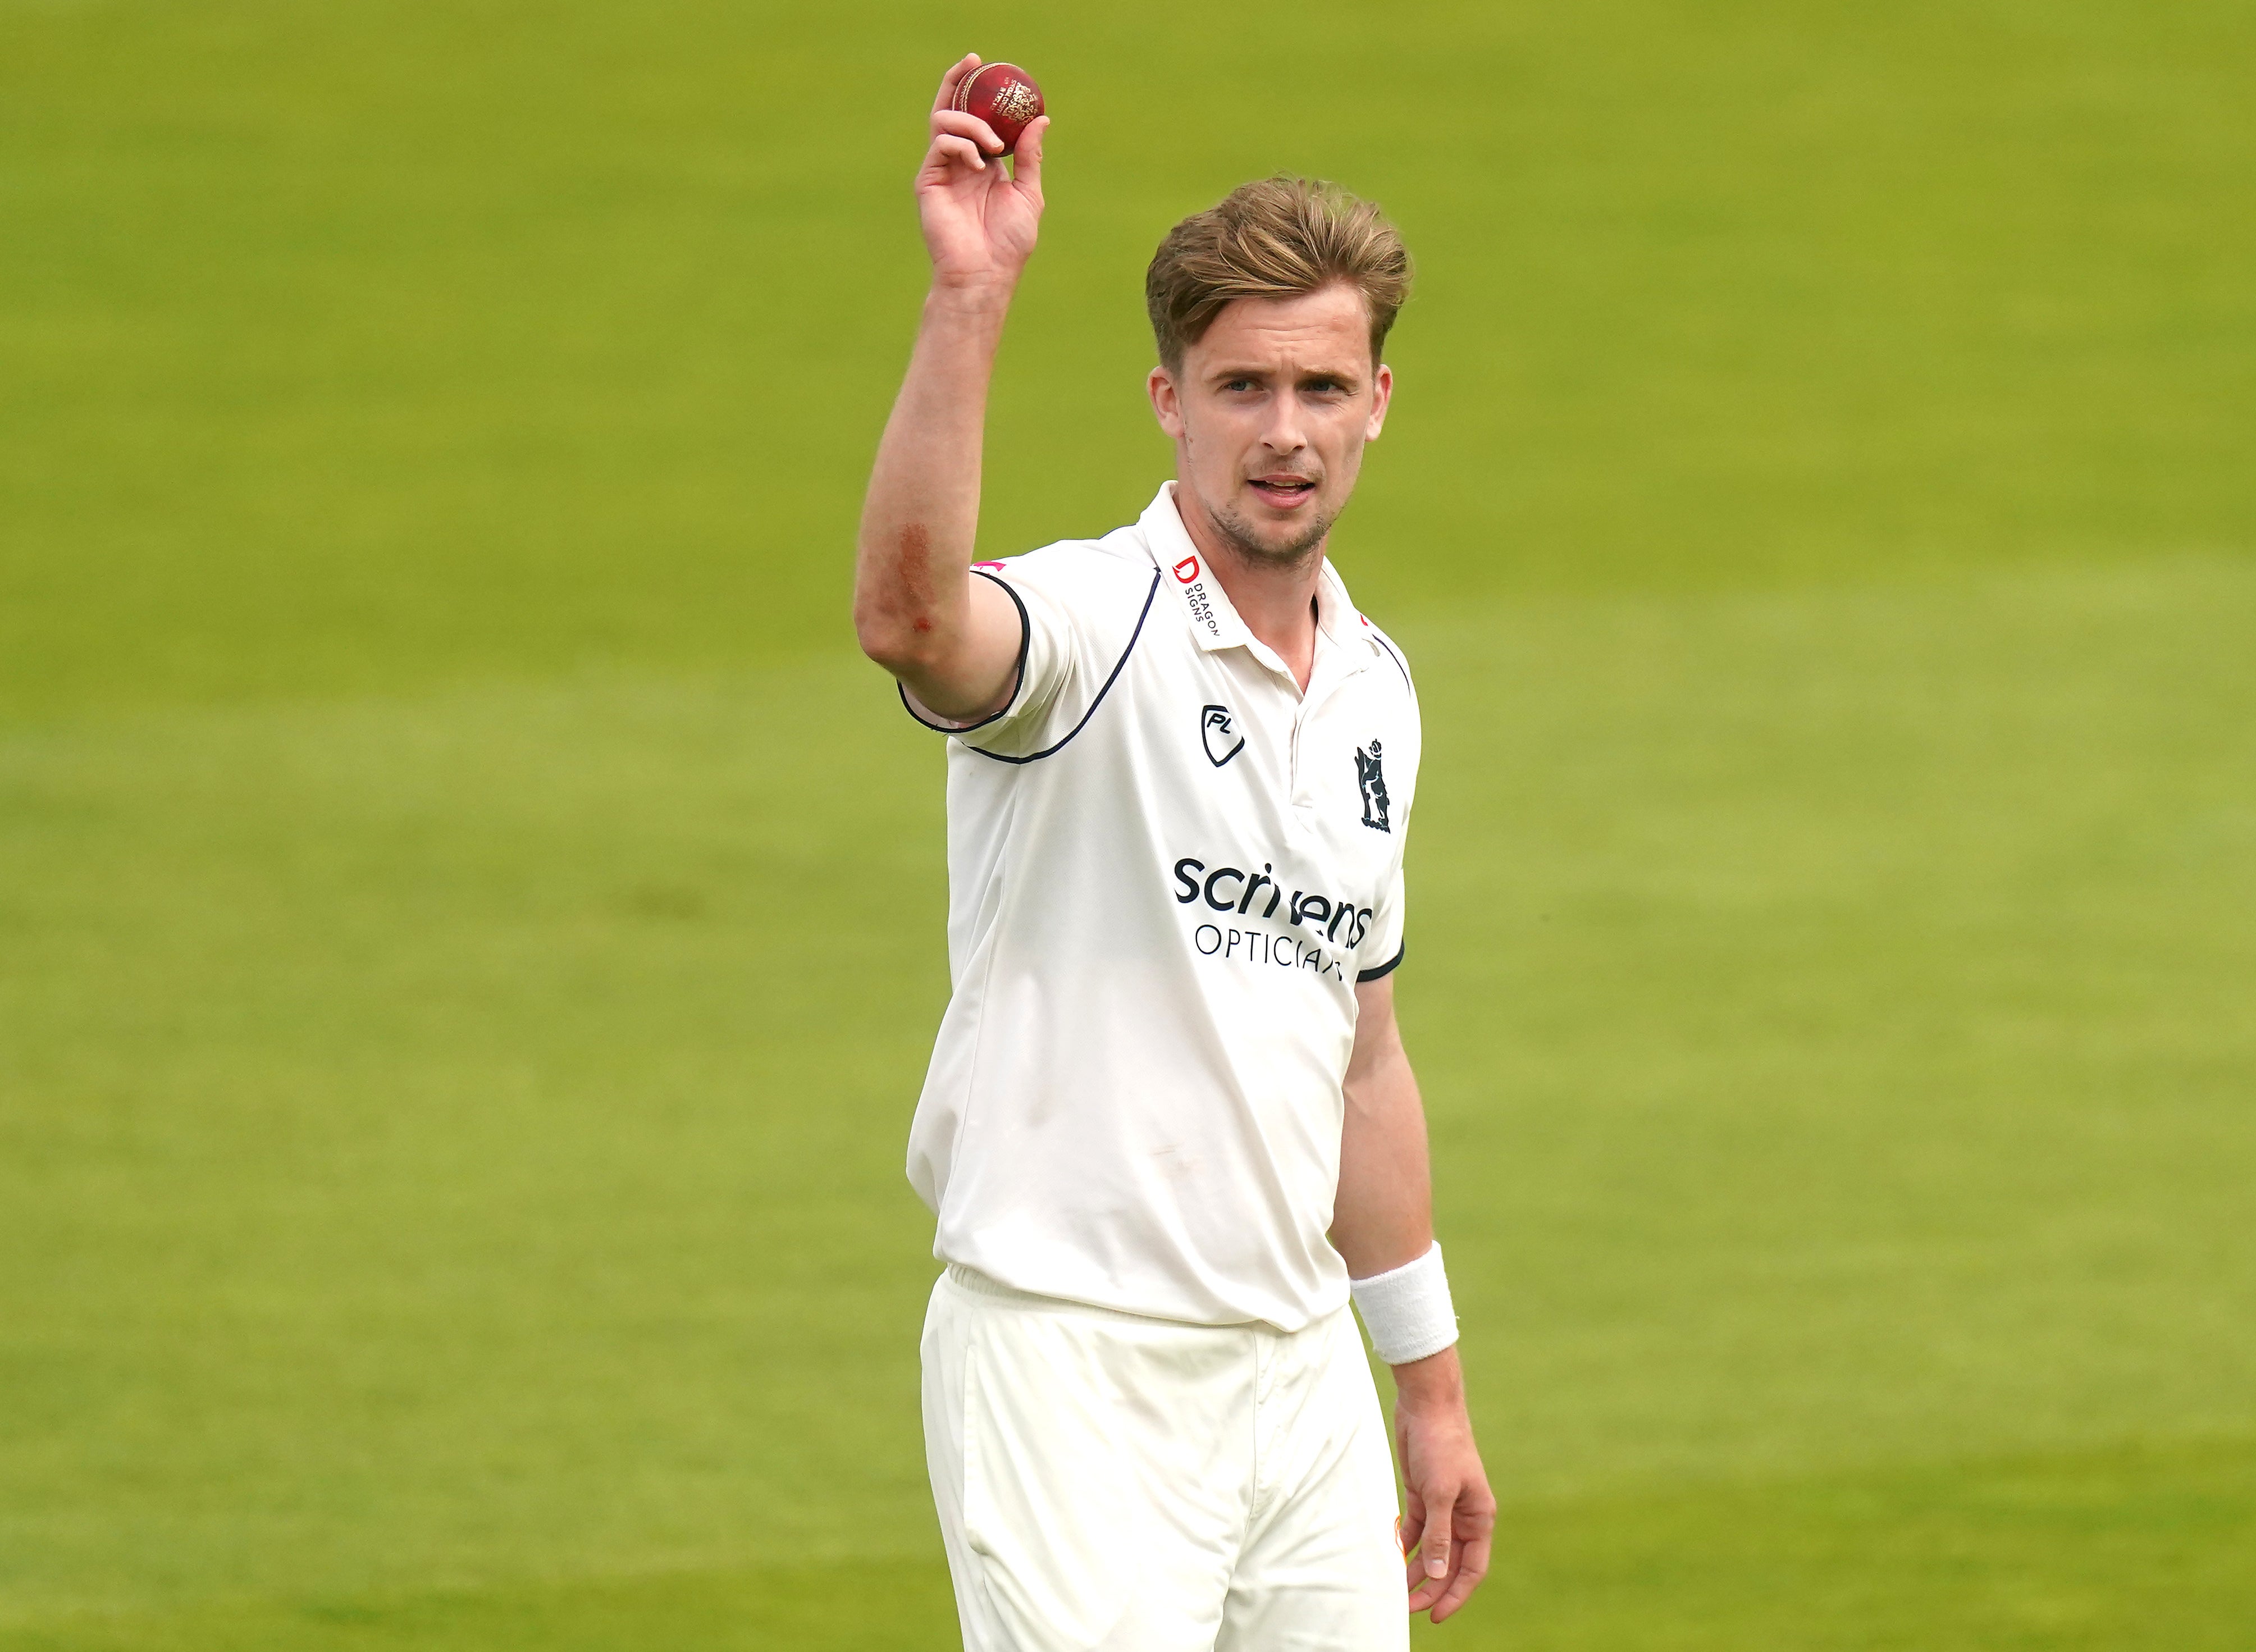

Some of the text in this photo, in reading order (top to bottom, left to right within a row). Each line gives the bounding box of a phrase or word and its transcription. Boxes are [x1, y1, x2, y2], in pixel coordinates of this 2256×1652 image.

[1185, 587, 1204, 622] SIGNS
[1194, 583, 1220, 637] DRAGON
[1206, 713, 1231, 734] PL
[1195, 924, 1342, 982] OPTICIA
